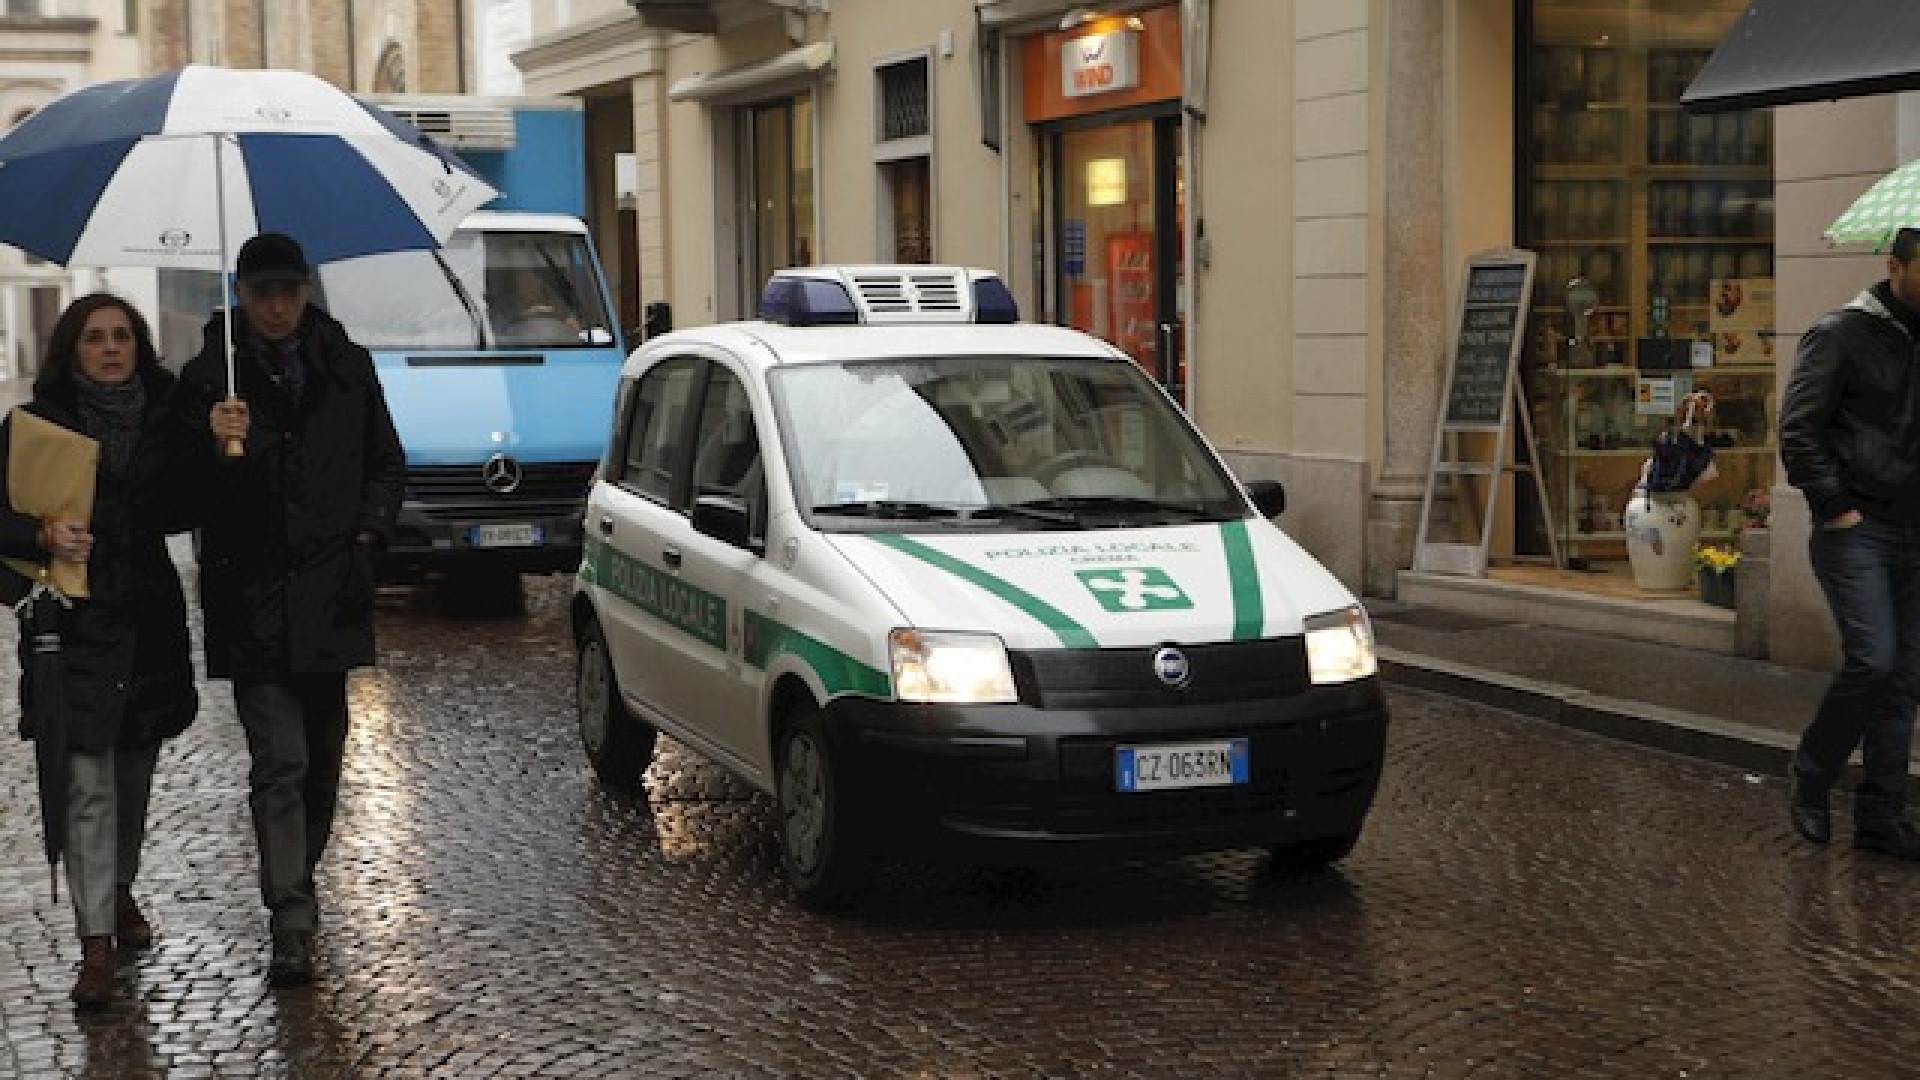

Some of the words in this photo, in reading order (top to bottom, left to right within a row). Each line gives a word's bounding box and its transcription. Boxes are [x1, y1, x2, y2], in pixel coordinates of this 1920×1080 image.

[1072, 64, 1114, 89] WIND
[984, 545, 1089, 561] POLIZIA
[1094, 542, 1200, 553] LOCALE
